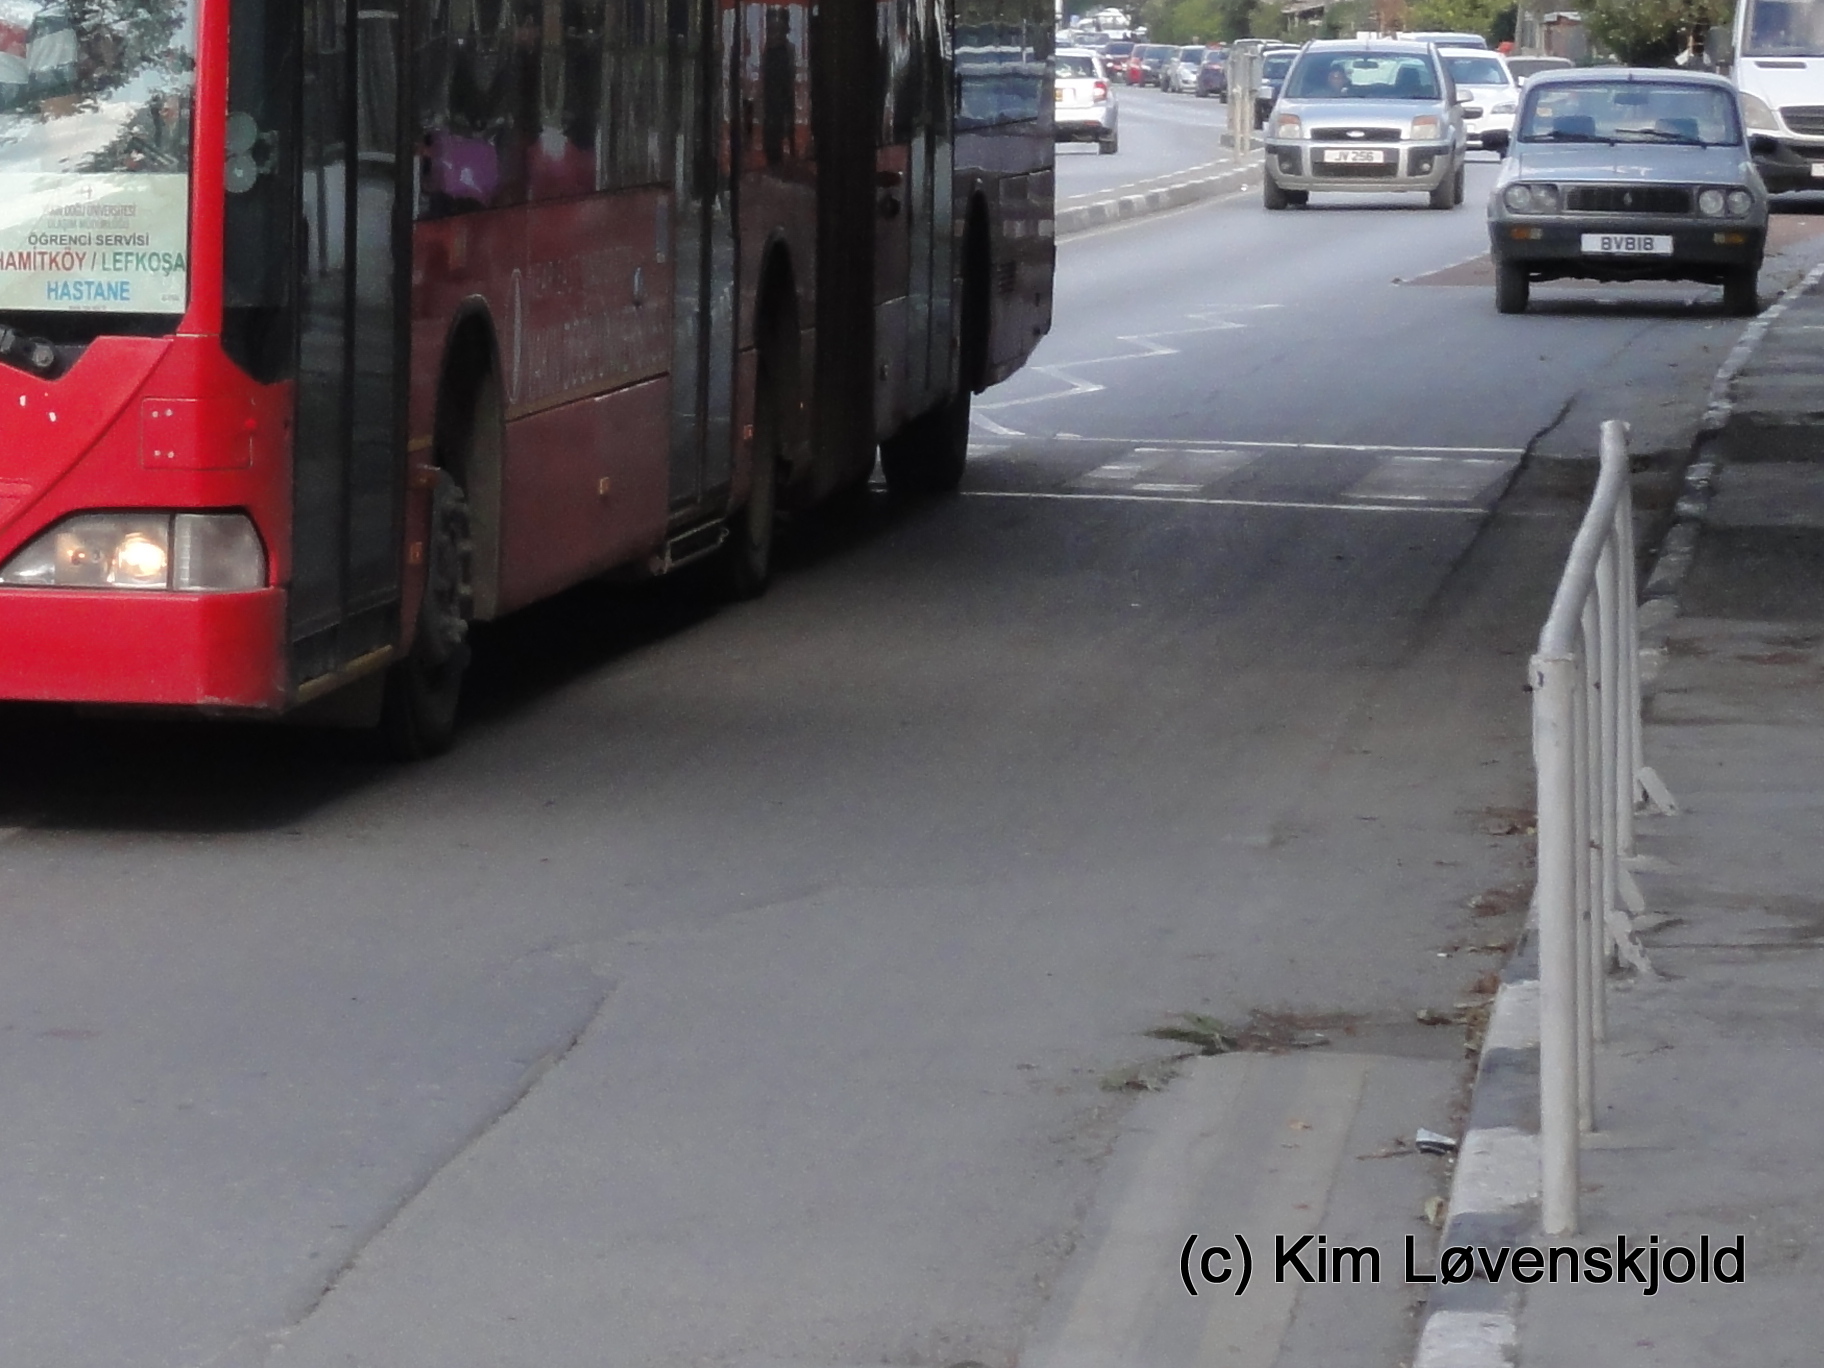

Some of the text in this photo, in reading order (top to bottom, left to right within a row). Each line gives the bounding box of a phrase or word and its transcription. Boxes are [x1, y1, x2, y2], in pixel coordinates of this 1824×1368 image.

[28, 232, 150, 247] ÖĞRENCİ SERVİSİ
[102, 251, 186, 277] LEFKOŞA
[46, 281, 130, 302] HASTANE
